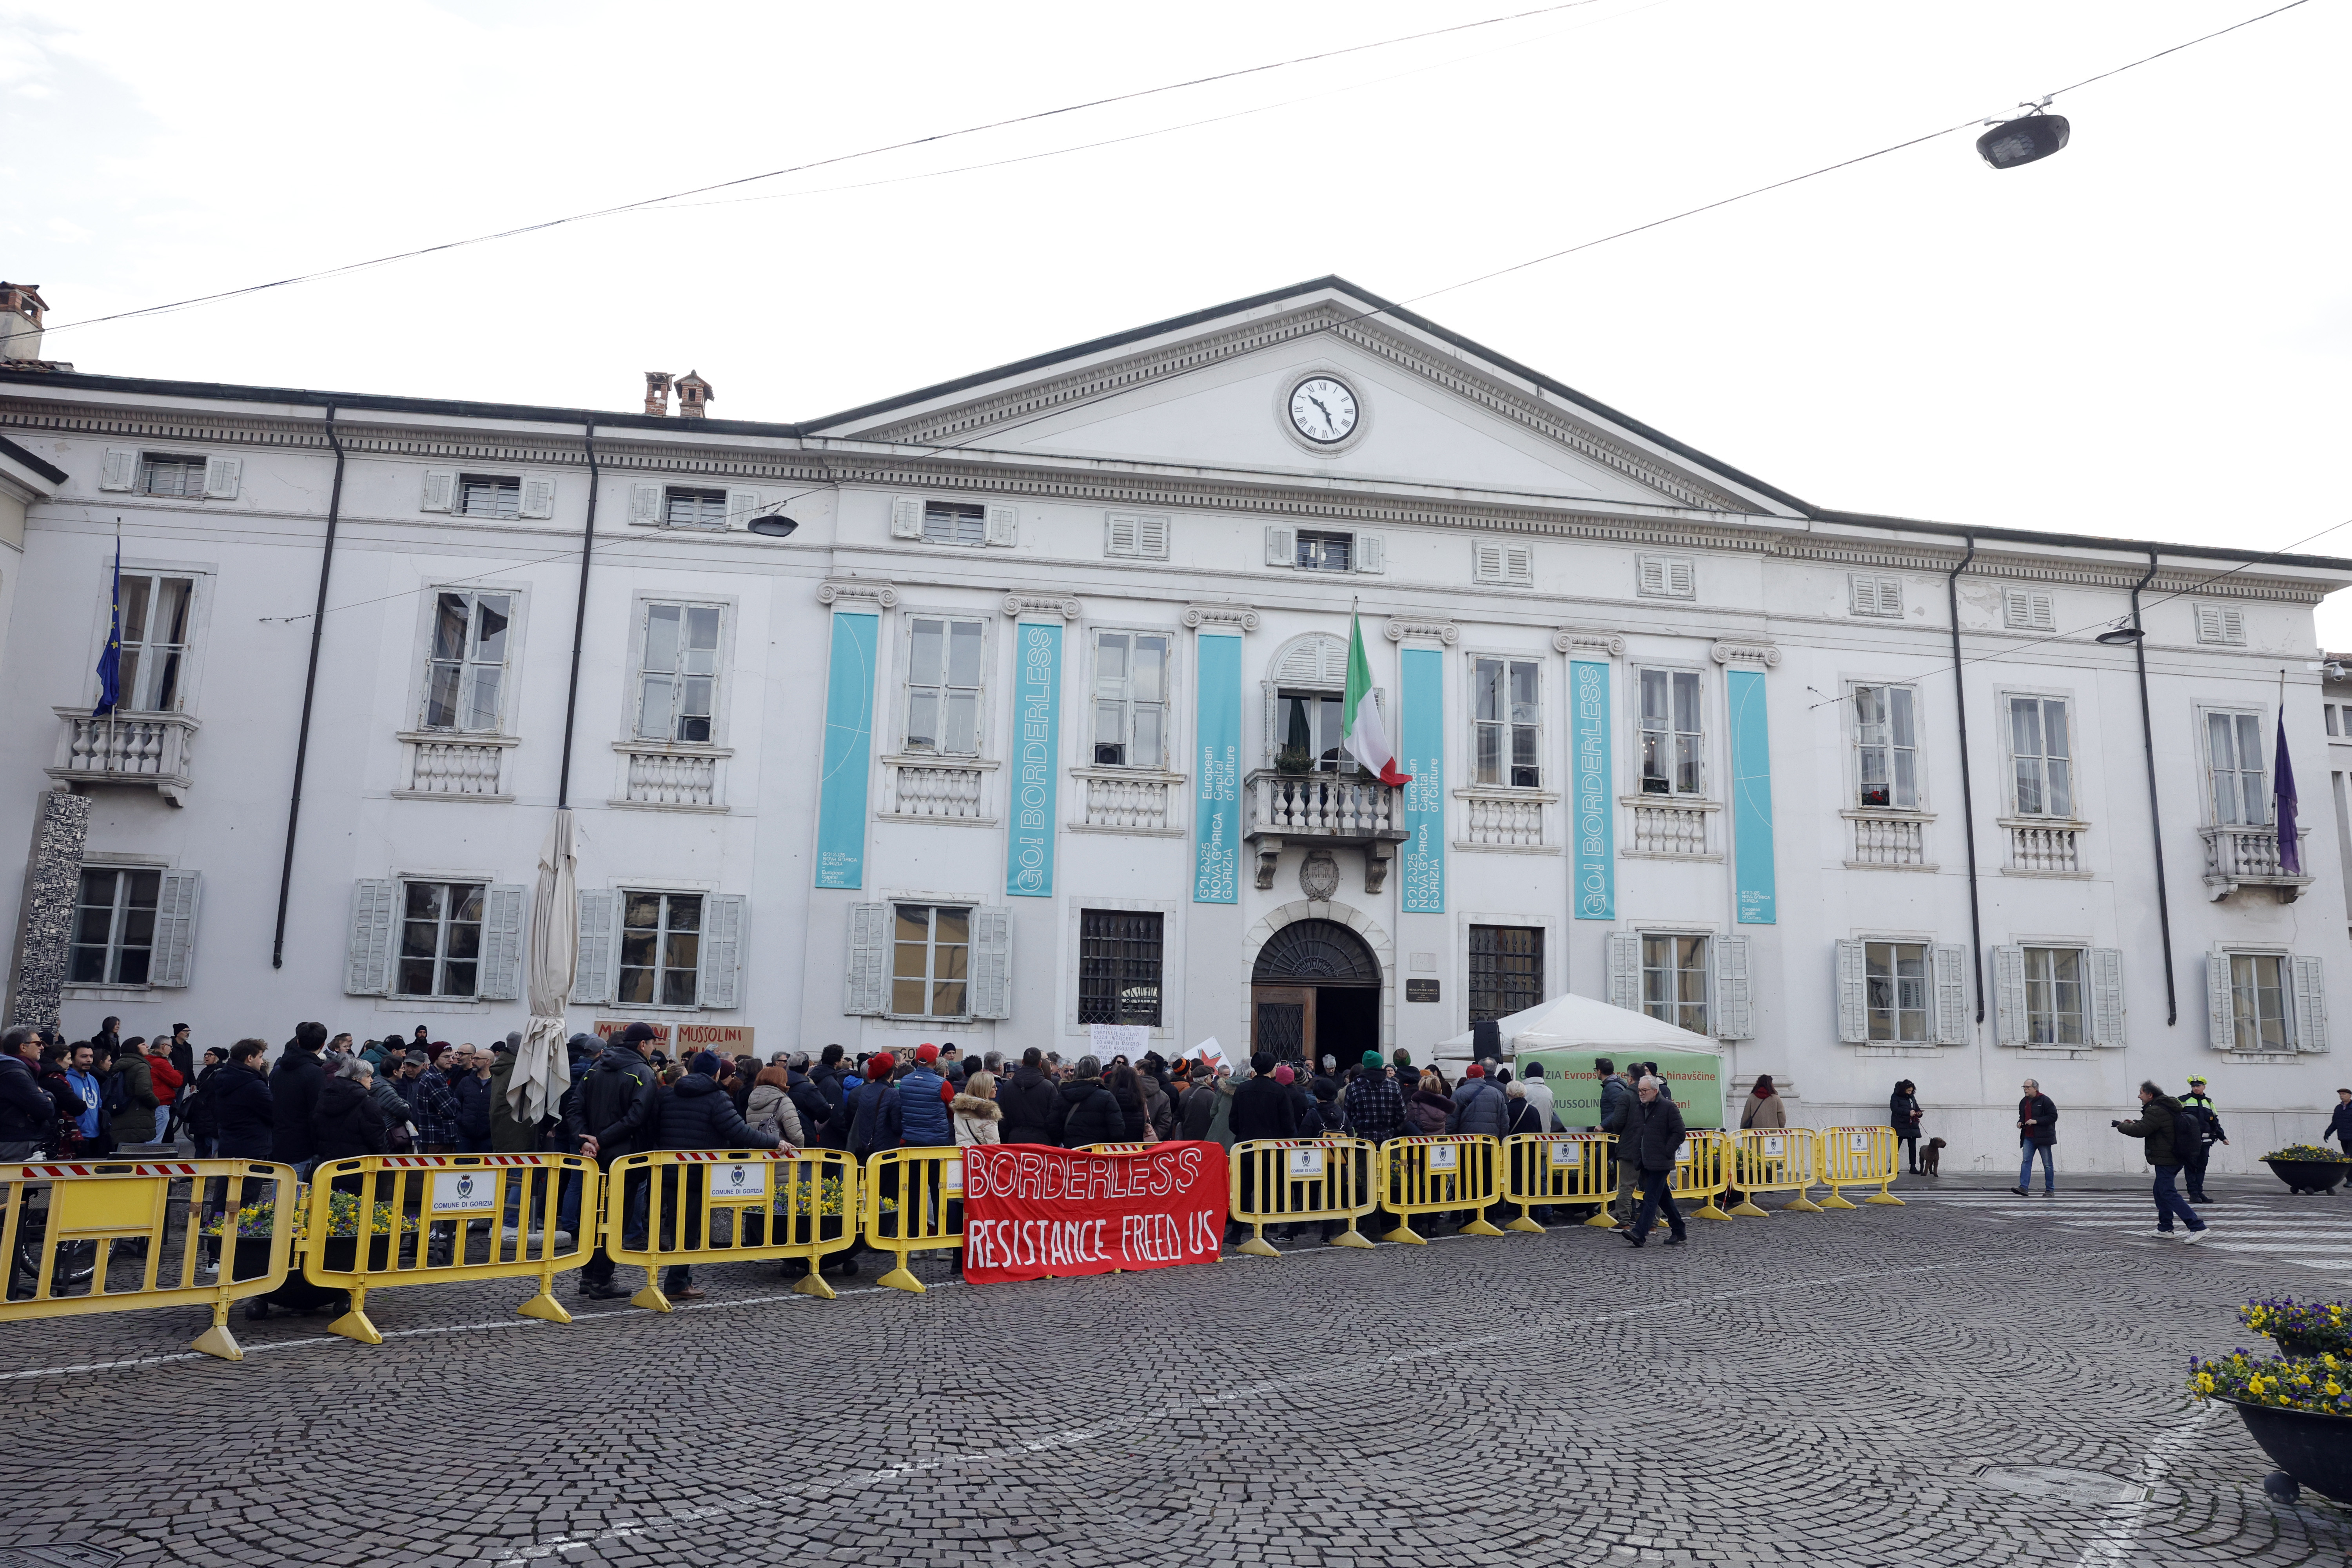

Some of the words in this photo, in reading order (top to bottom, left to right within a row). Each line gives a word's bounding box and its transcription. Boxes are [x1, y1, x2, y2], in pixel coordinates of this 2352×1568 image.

[1305, 384, 1315, 394] XI
[1318, 382, 1327, 390] XII
[1297, 417, 1308, 428] VIII
[1307, 425, 1316, 436] VII
[1322, 430, 1328, 438] VI
[1341, 419, 1351, 428] IIII
[1020, 628, 1053, 829] BORDERLESS
[1202, 746, 1214, 799] European
[1214, 760, 1225, 800] Capital
[1225, 746, 1235, 786] Culture
[1429, 758, 1438, 798] Culture
[1579, 665, 1604, 856] BORDERLESS
[1225, 789, 1234, 801] of
[1408, 759, 1419, 811] European
[1418, 773, 1429, 811] Capital
[1429, 801, 1438, 812] of
[1212, 813, 1222, 860] GORICA
[1419, 824, 1428, 871] GORICA
[1018, 837, 1044, 892] GO!
[1210, 864, 1221, 898] NOVA
[1222, 848, 1233, 899] GORIZIA
[1430, 858, 1439, 908] GORIZIA
[1418, 874, 1428, 907] NOVA
[1583, 864, 1605, 916] GO!
[679, 1026, 742, 1043] MUSSOLINI
[1667, 1071, 1715, 1081] hinavščine
[967, 1147, 1201, 1200] BORDERLESS
[967, 1219, 1112, 1269] RESISTANCE
[1122, 1213, 1181, 1261] FREED
[1189, 1210, 1218, 1255] US
